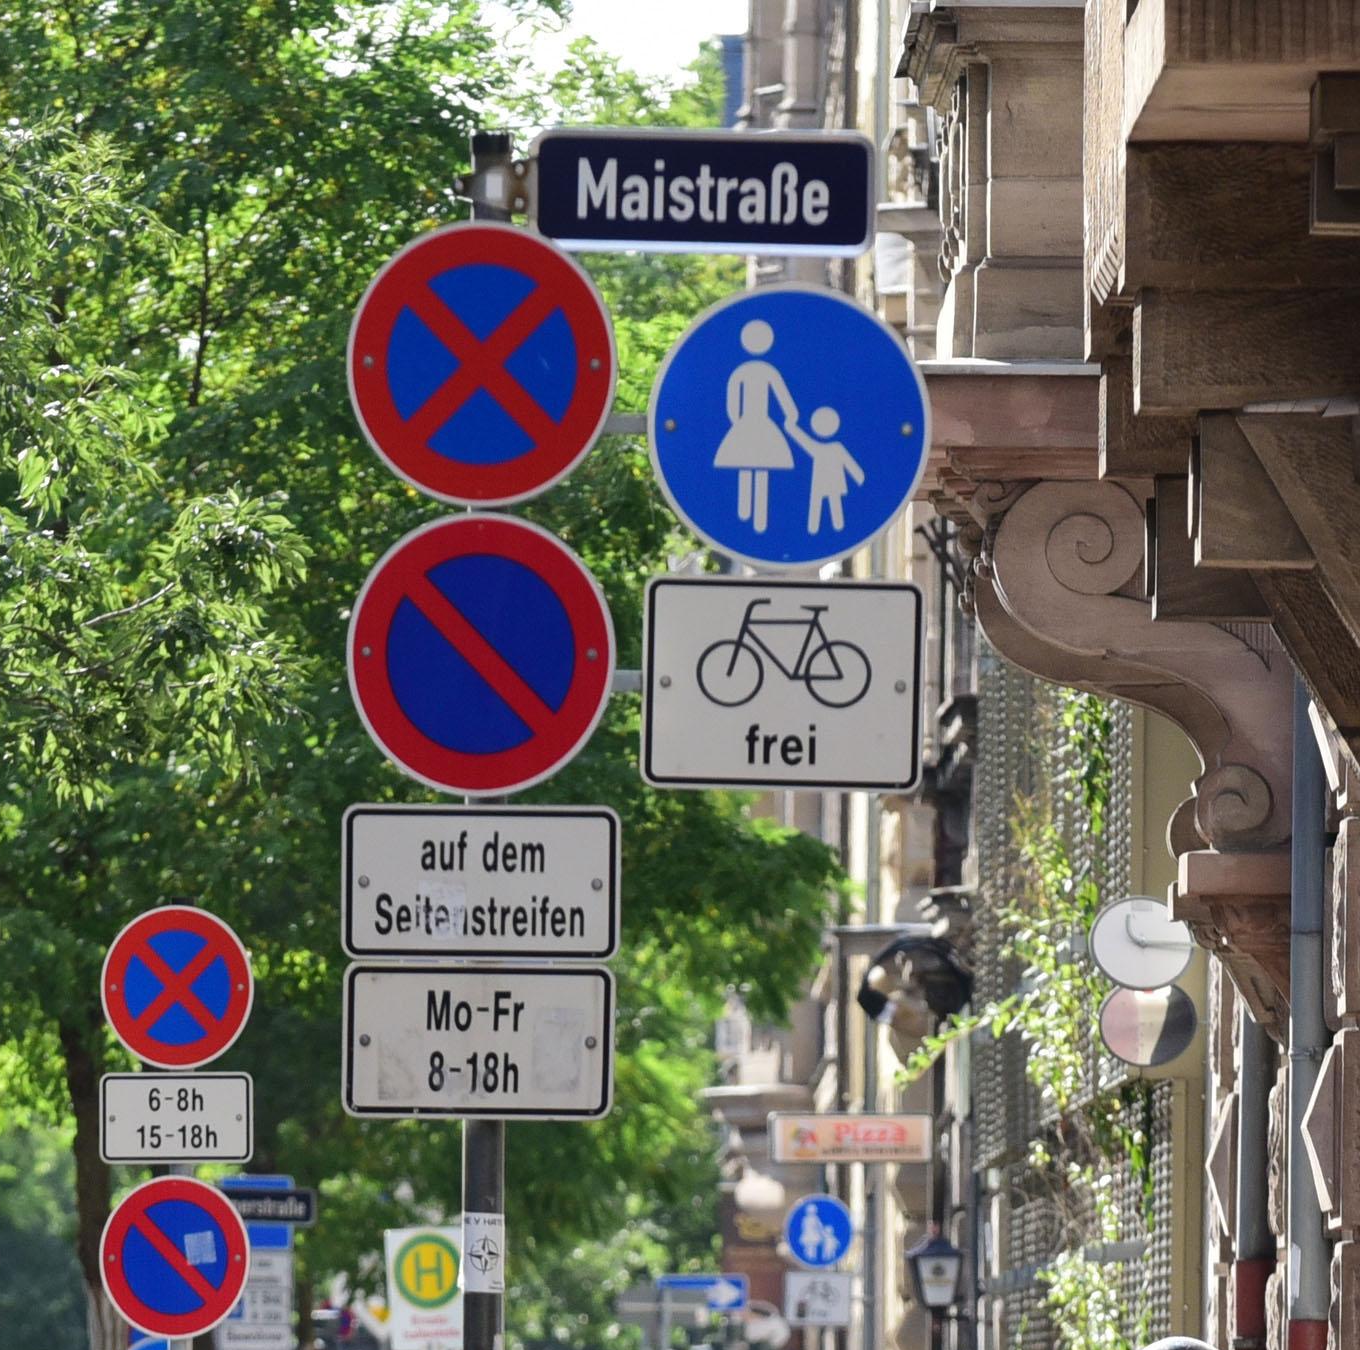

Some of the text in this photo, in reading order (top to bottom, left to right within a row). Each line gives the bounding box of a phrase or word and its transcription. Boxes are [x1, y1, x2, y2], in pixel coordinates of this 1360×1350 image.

[576, 156, 830, 226] Maistraße
[745, 724, 816, 765] frei
[420, 830, 545, 873] auf dem
[426, 990, 524, 1032] Mo-Fr
[428, 1051, 519, 1093] 8-18h
[148, 1087, 204, 1112] 6-8h
[136, 1124, 217, 1149] 15-18h
[833, 1121, 908, 1144] Pizza
[414, 1250, 443, 1292] H
